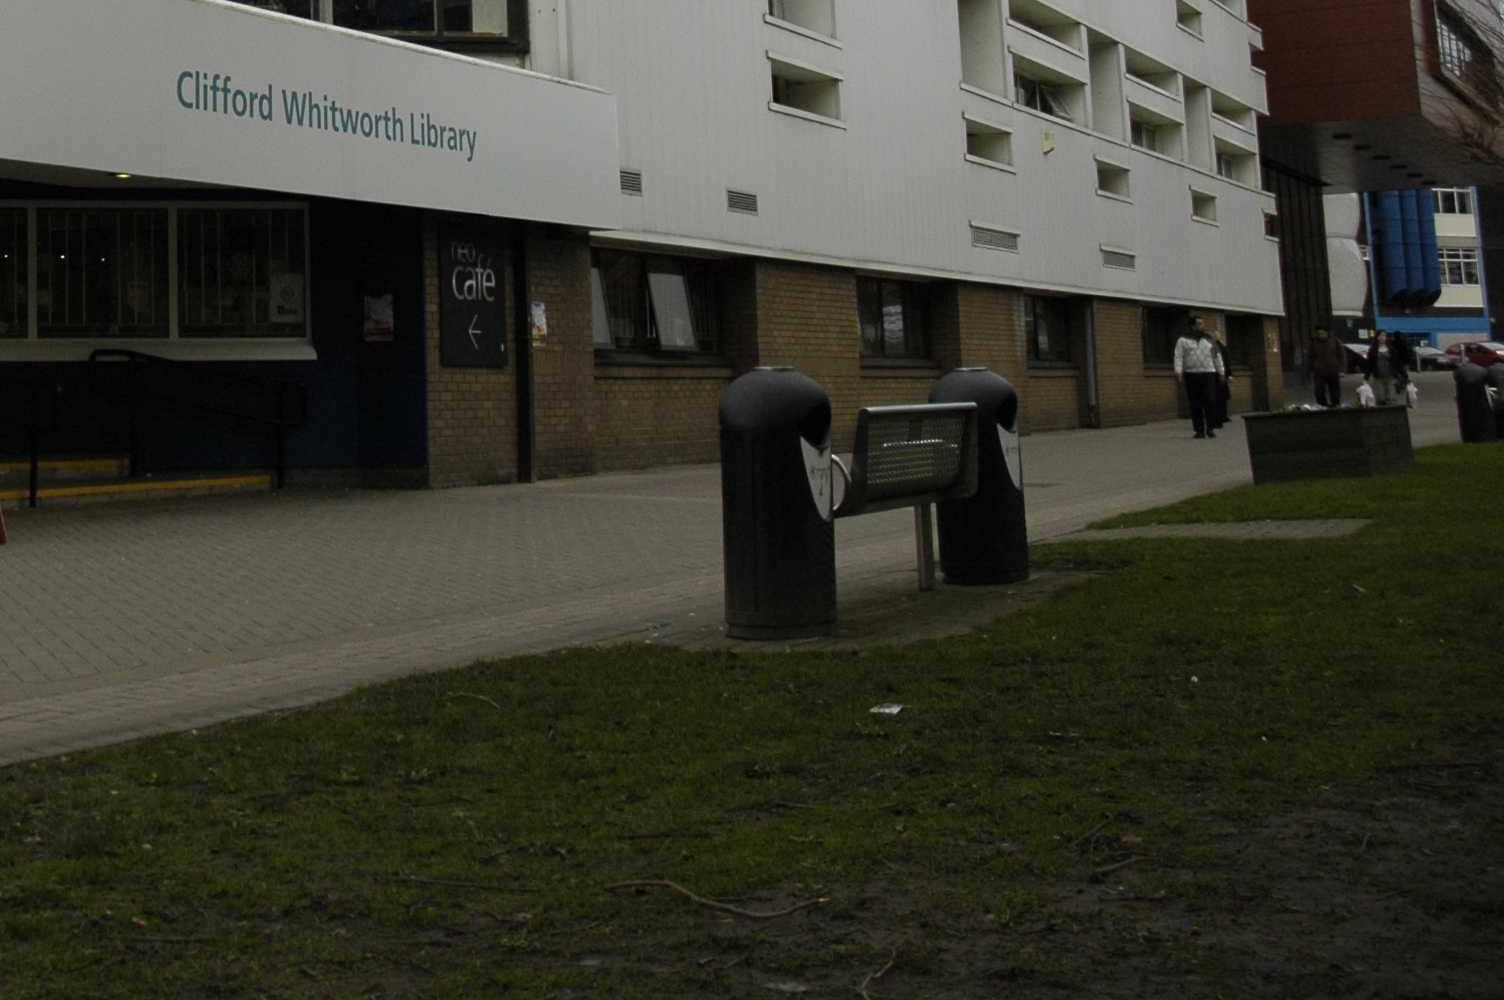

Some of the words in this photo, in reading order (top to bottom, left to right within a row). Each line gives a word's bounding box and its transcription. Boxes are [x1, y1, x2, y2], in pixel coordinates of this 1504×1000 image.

[176, 70, 274, 122] Clifford
[281, 88, 404, 143] Whitworth
[410, 112, 477, 163] Library
[450, 241, 476, 263] neo
[452, 252, 496, 302] café
